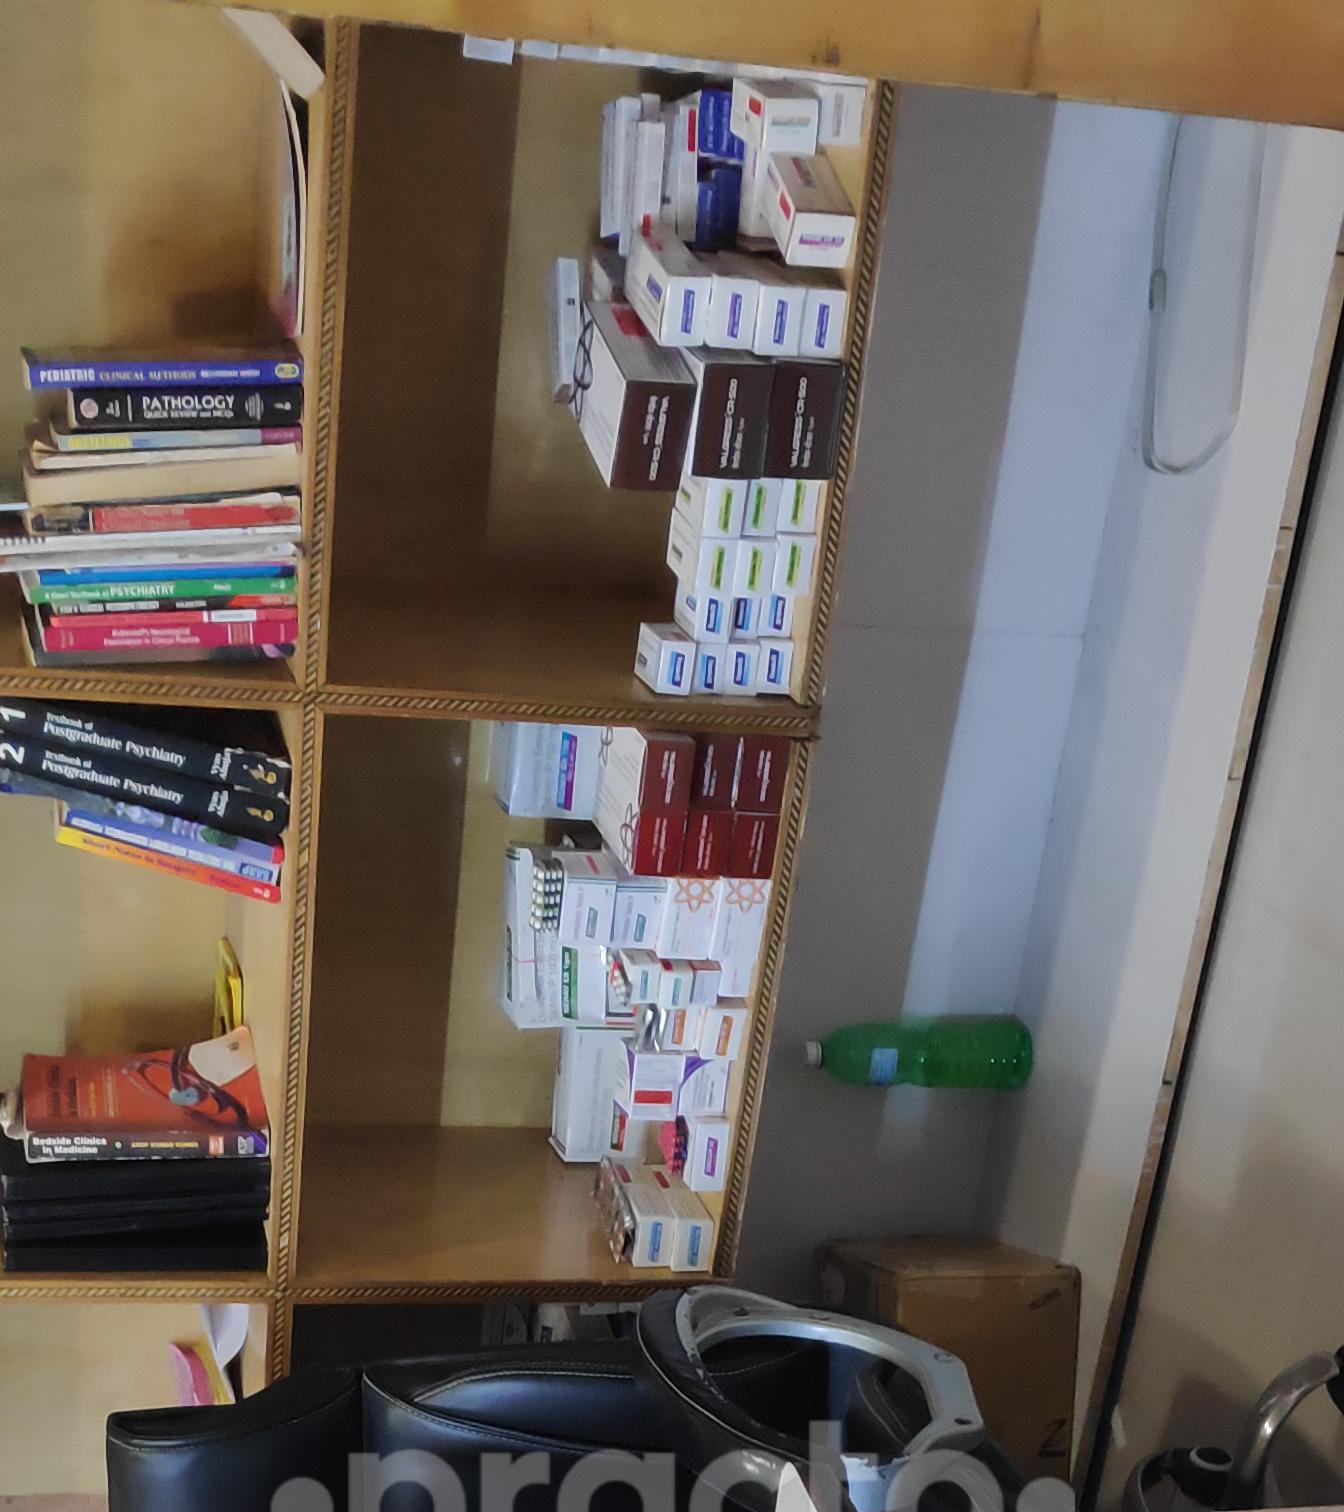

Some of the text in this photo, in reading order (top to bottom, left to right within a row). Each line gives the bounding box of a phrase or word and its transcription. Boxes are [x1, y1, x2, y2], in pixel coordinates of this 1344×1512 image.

[39, 367, 95, 383] PEDIATRIC
[142, 394, 235, 411] PATHOLOGY
[110, 584, 175, 597] PSYCHIATRY
[43, 721, 187, 768] Postgraduate Psychiatry
[41, 759, 185, 805] Postgraduate Psychiatry
[32, 1136, 107, 1146] Bedside Clinics
[54, 1145, 98, 1154] Medicine
